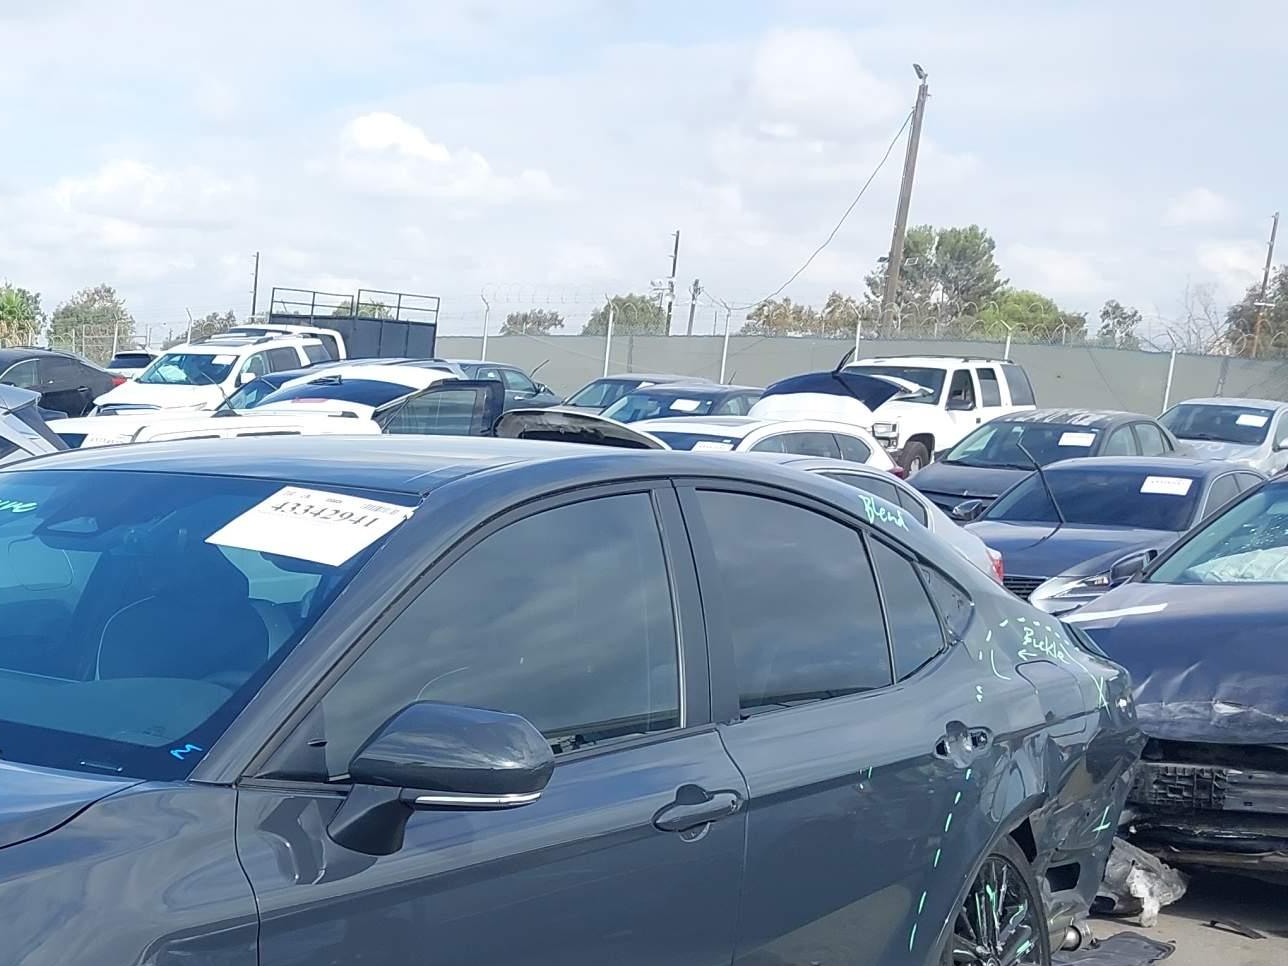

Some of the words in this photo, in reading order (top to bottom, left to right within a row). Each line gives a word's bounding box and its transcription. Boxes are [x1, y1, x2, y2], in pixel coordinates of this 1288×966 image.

[271, 501, 380, 527] 43342941
[857, 494, 910, 532] Blend
[1022, 626, 1071, 665] Buckle
